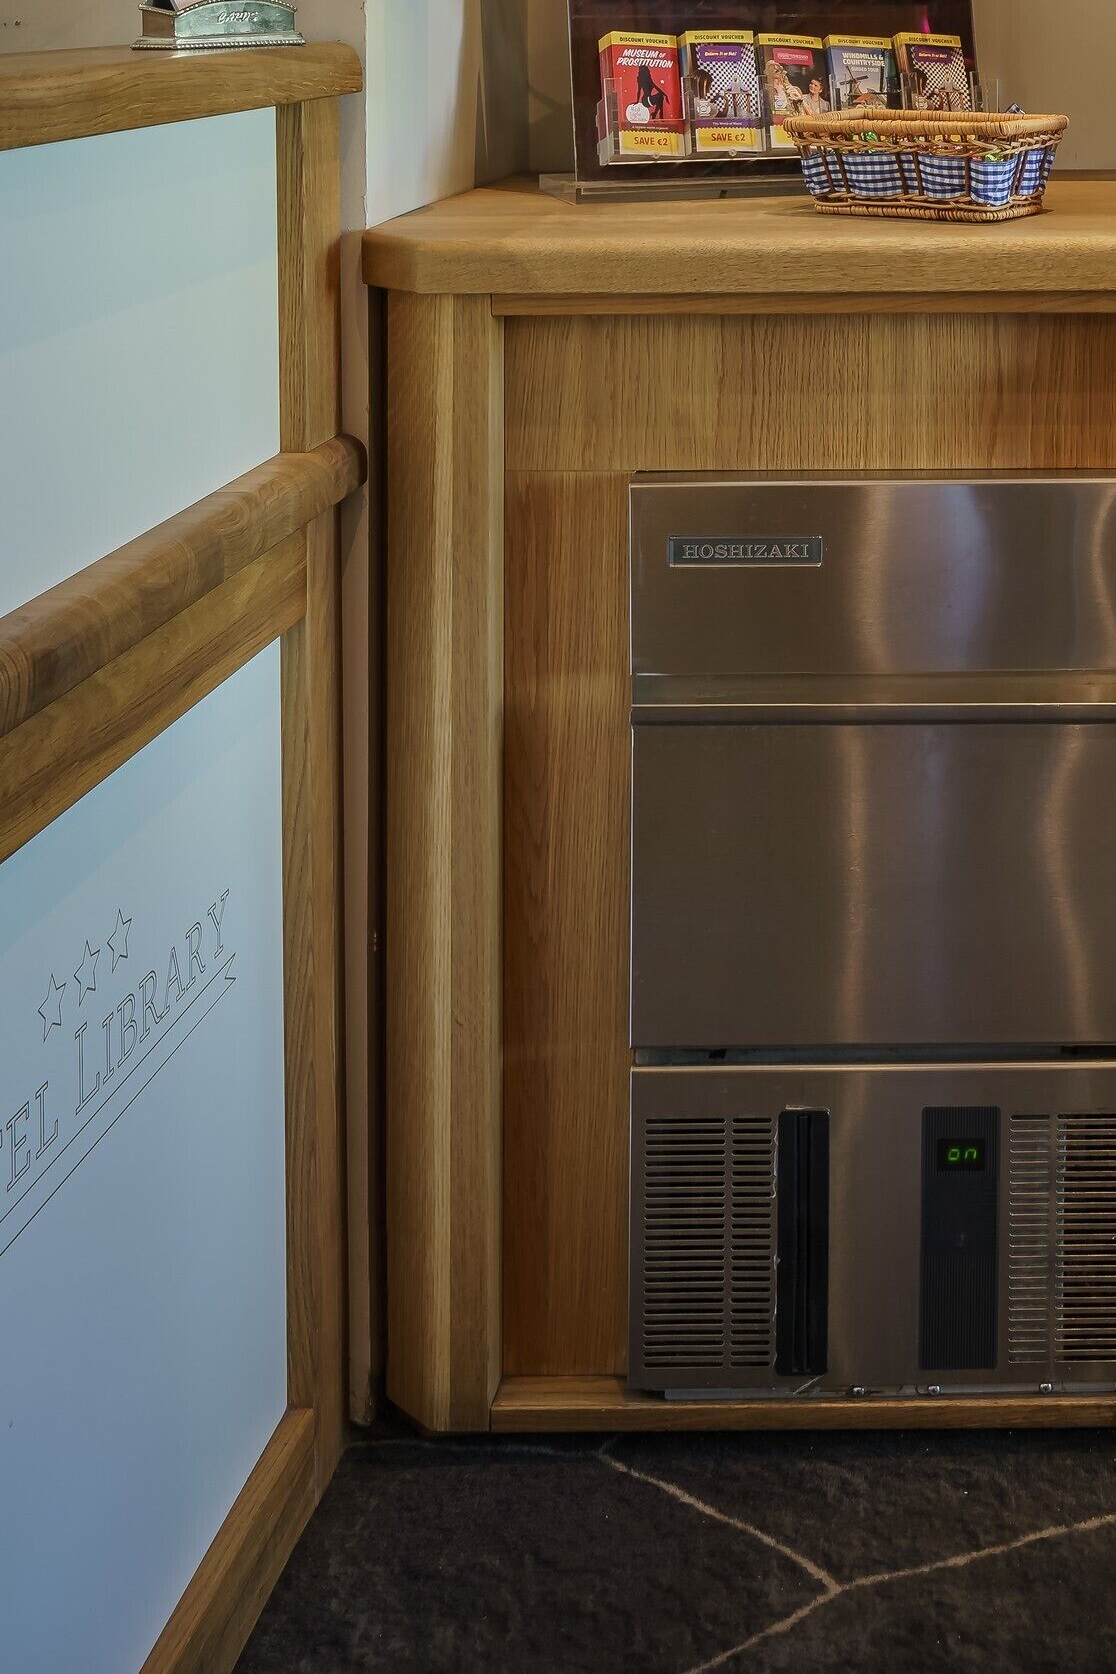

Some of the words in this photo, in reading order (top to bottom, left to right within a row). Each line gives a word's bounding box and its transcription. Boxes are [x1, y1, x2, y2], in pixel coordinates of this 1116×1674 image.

[217, 11, 259, 24] CARDS
[622, 48, 658, 58] MUSEUM
[842, 52, 878, 60] WINDMILLS
[616, 57, 674, 68] PROSTITUTION
[842, 58, 886, 67] COUNTRYSIDE
[633, 137, 655, 145] SAVE
[657, 138, 669, 146] €2
[710, 133, 732, 142] SAVE
[734, 133, 746, 142] €2
[682, 543, 810, 559] HOSHIZAKI
[74, 888, 230, 1116] LIBRARY
